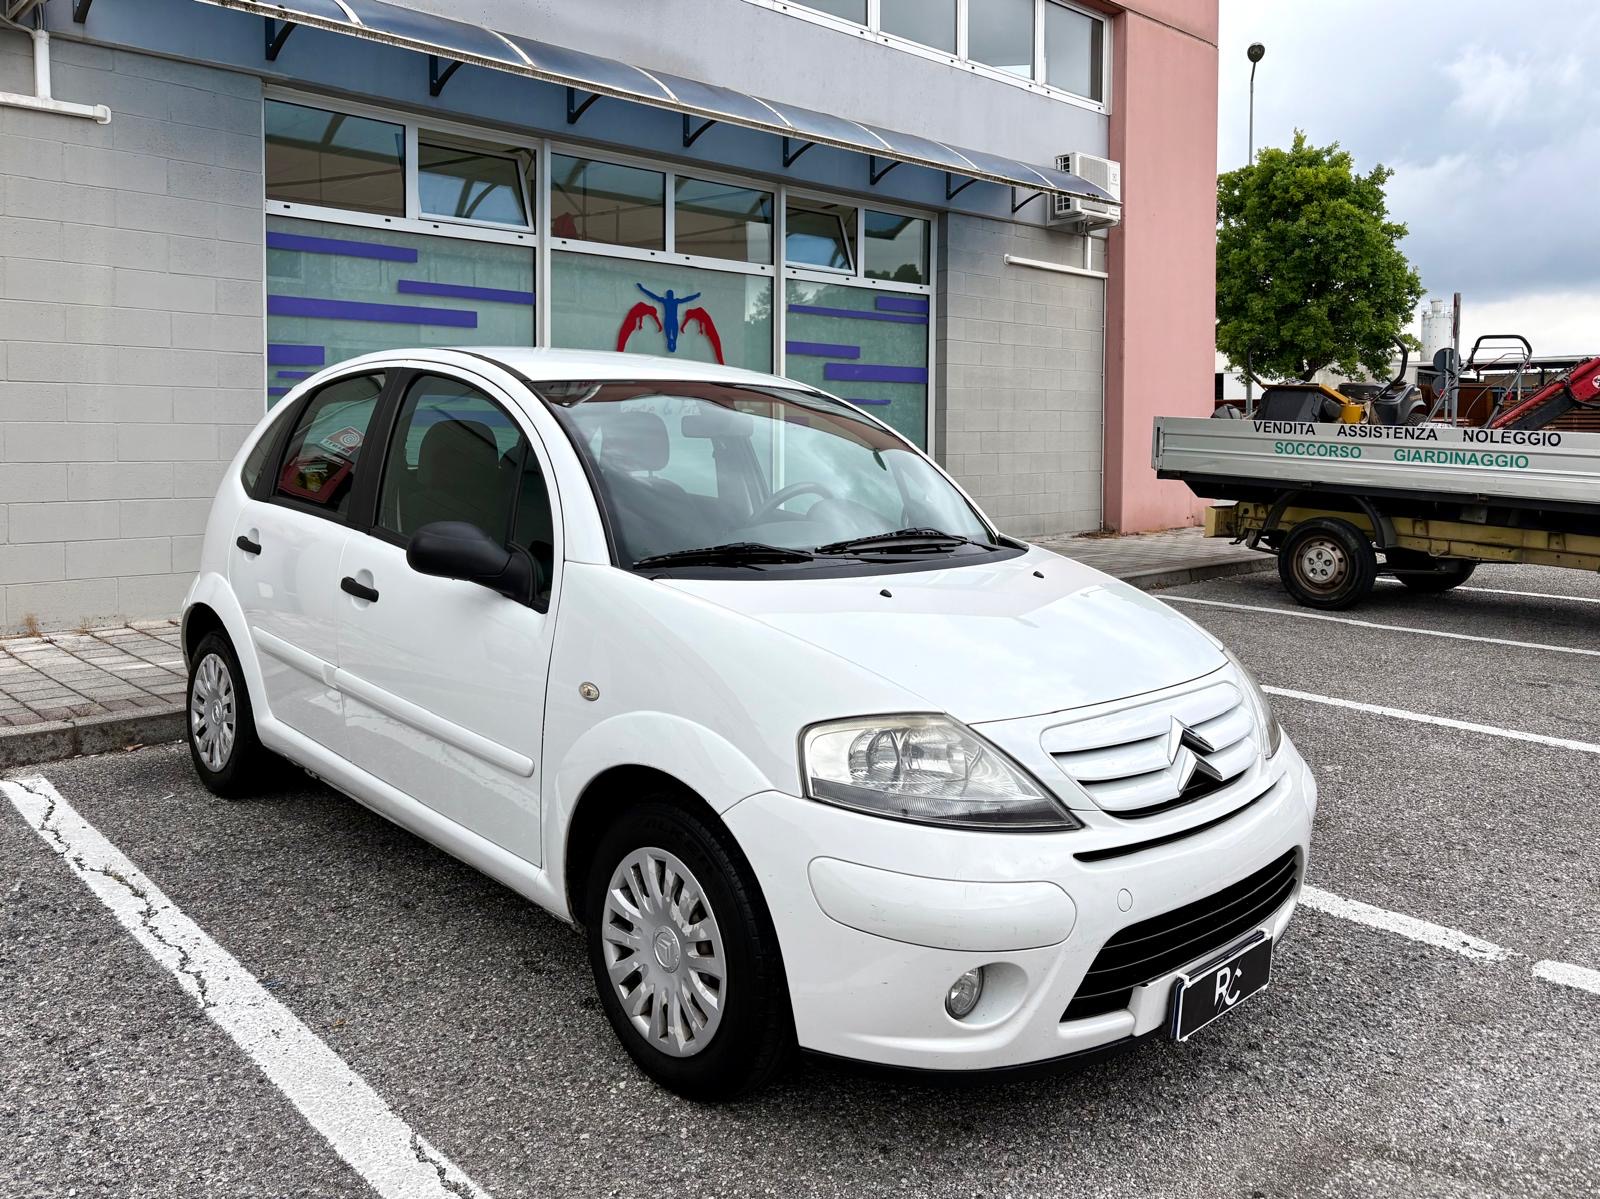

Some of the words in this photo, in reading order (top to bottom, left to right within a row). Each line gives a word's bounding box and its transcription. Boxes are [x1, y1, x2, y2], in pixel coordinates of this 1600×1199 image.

[1253, 420, 1316, 436] VENDITA
[1336, 425, 1438, 442] ASSISTENZA
[1462, 429, 1562, 447] NOLEGGIO
[1274, 441, 1362, 459] SOCCORSO
[1393, 448, 1529, 469] GIARDINAGGIO
